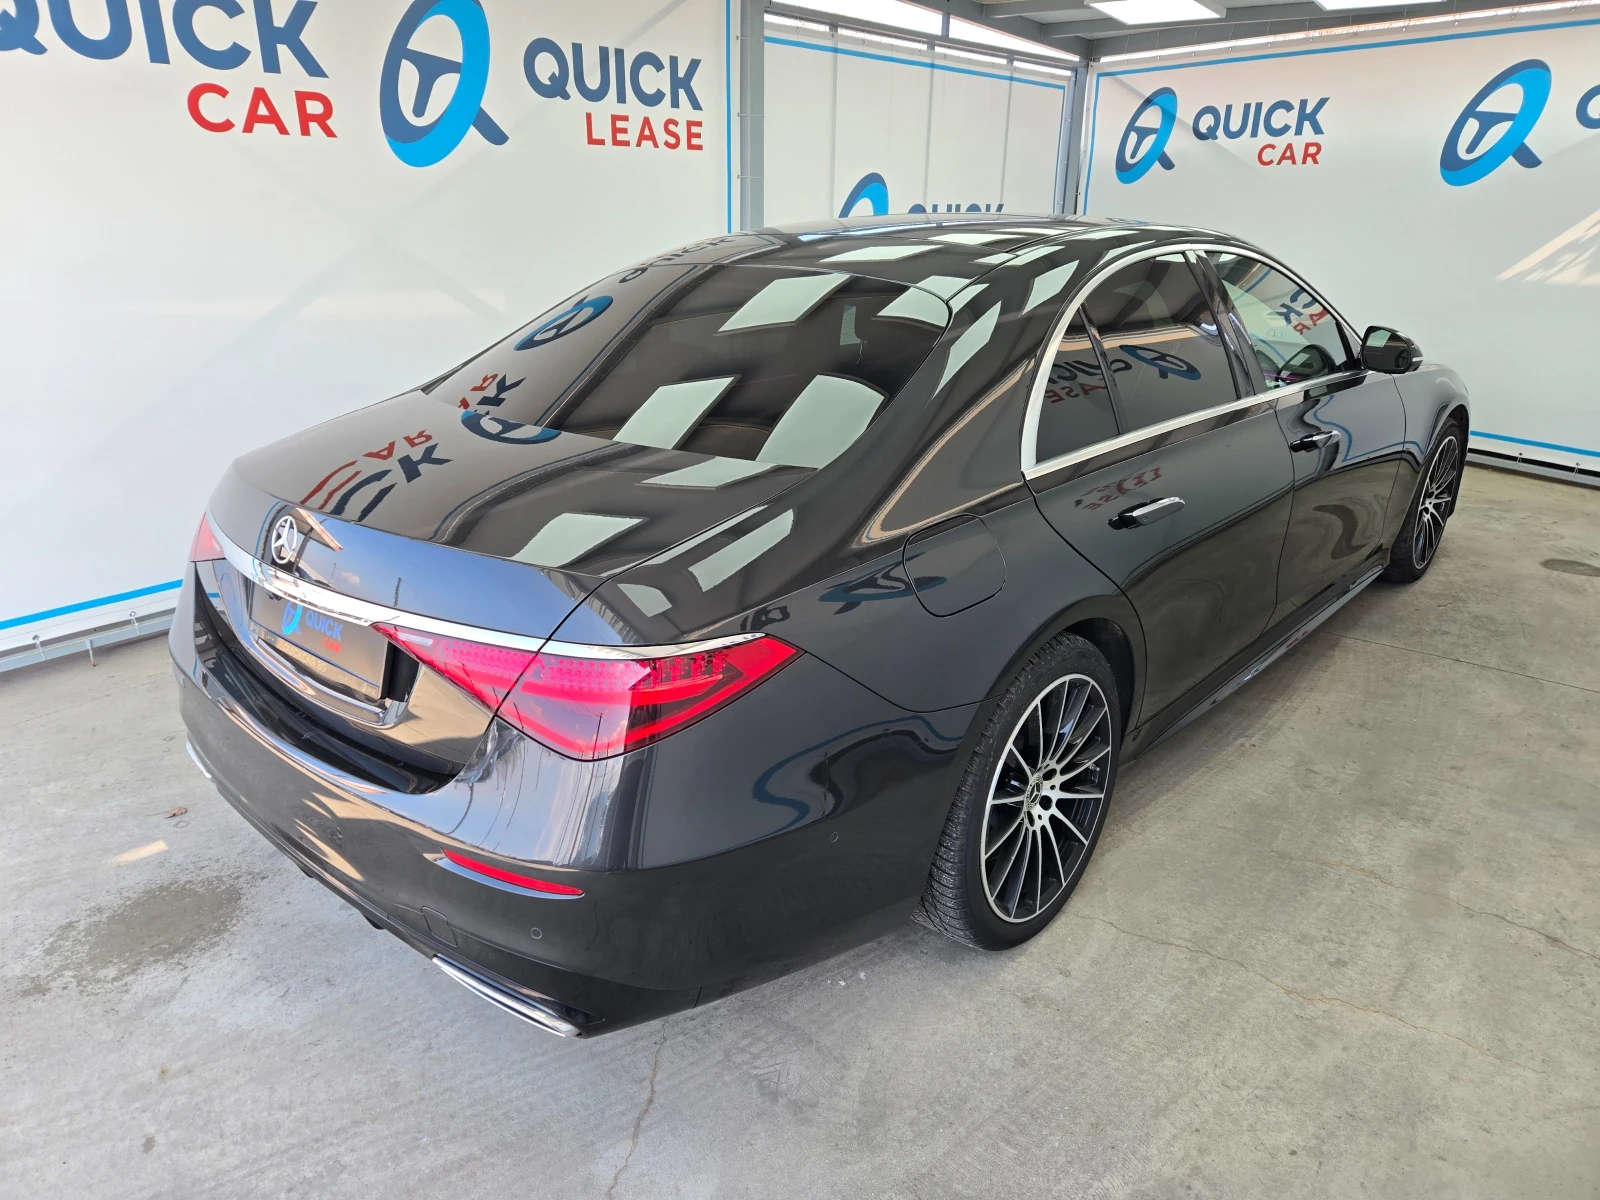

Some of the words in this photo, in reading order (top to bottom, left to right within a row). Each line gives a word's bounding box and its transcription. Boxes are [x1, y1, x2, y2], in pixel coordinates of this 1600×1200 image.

[523, 37, 703, 112] QUICK
[187, 82, 338, 139] CAR
[1192, 96, 1331, 141] QUICK
[585, 111, 703, 151] LEASE
[1257, 141, 1322, 167] CAR
[305, 609, 344, 642] QUICK
[321, 636, 342, 653] CAR
